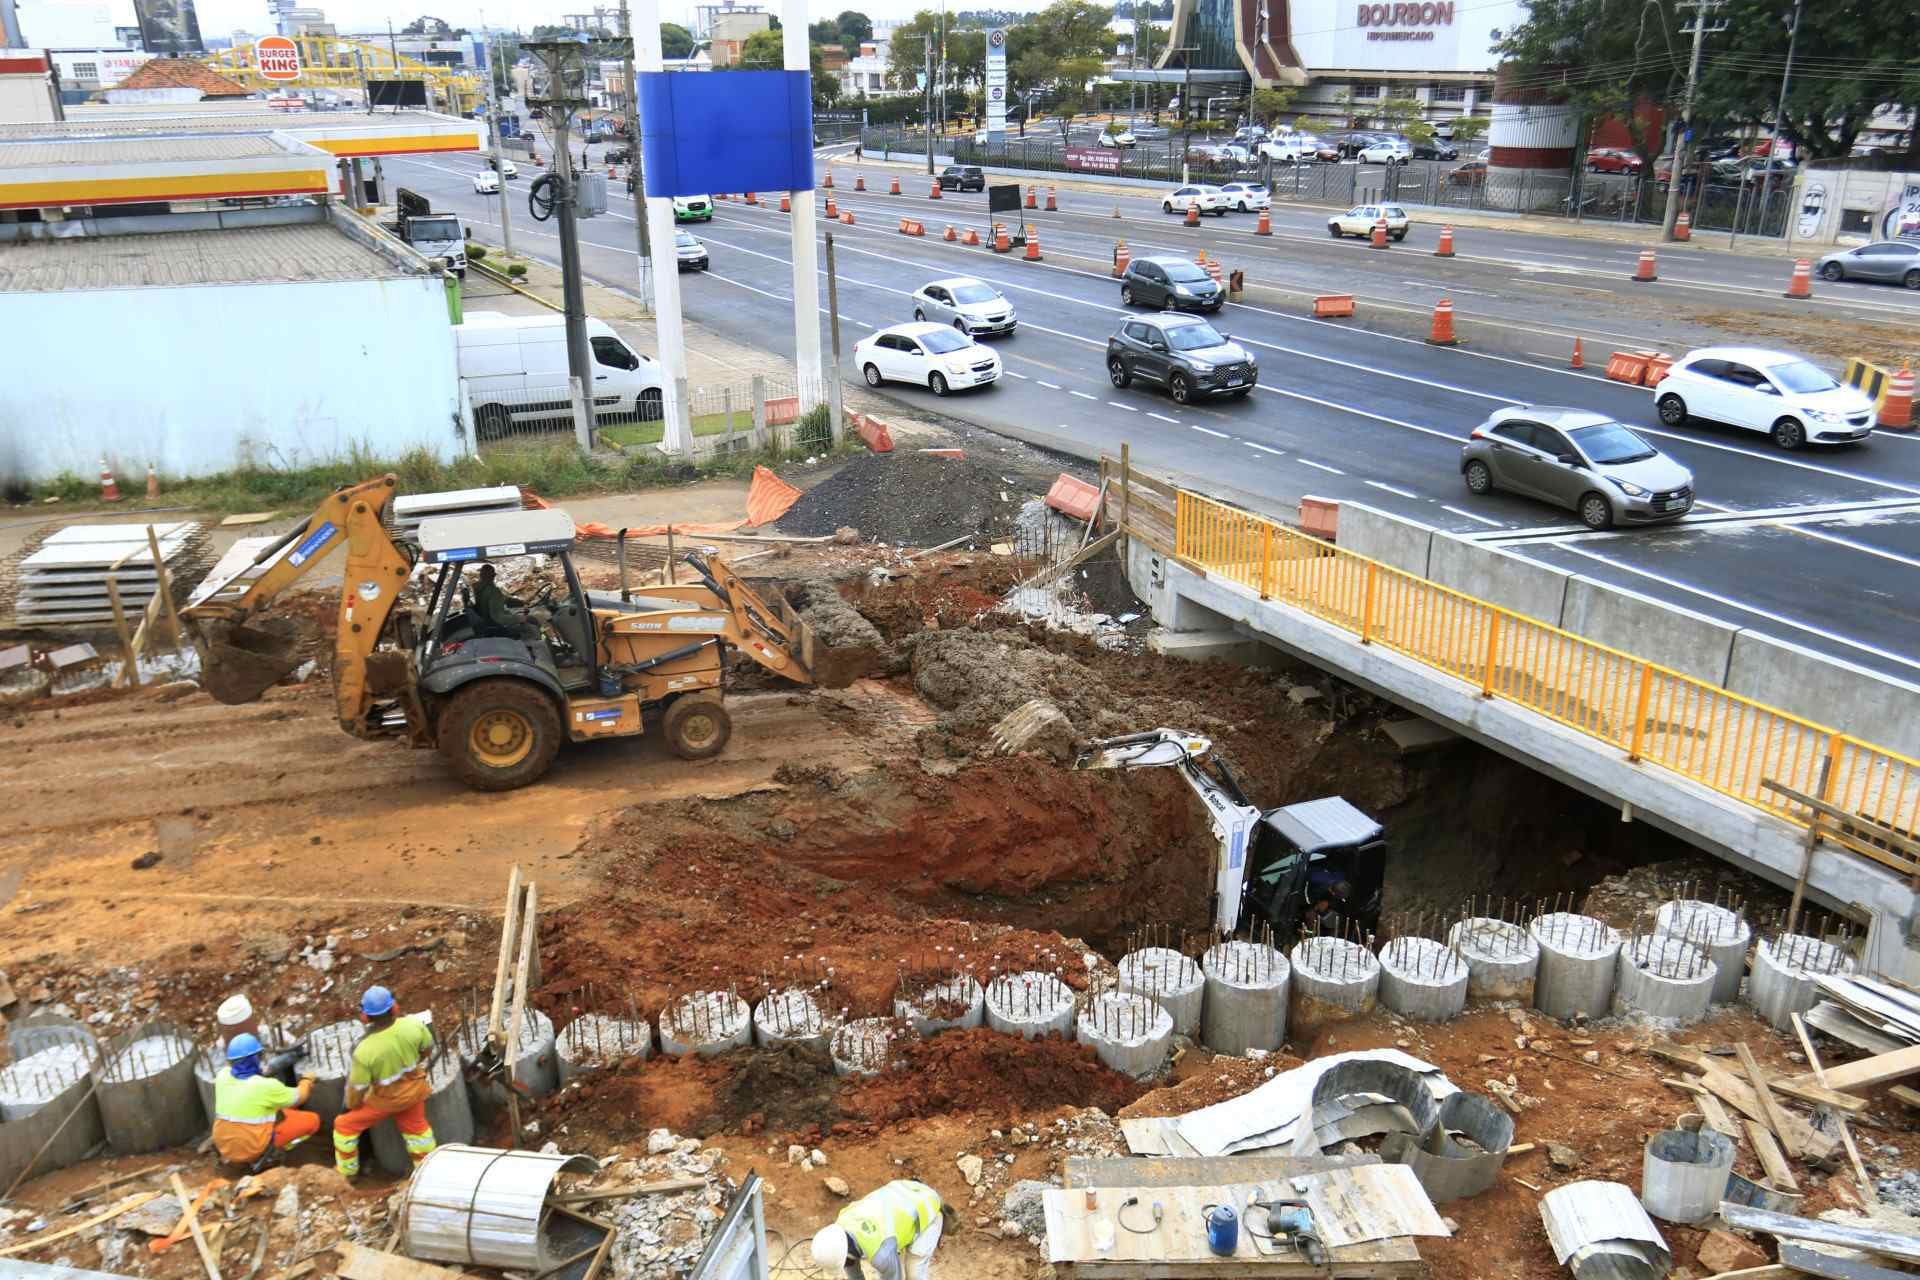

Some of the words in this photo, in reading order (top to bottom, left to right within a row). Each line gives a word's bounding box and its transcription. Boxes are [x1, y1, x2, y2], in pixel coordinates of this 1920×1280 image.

[1357, 2, 1454, 27] BOURBON
[1367, 31, 1434, 41] HIPERMERCADO
[259, 50, 297, 58] BURGER
[260, 59, 298, 71] KING
[1208, 793, 1227, 813] Bobcat
